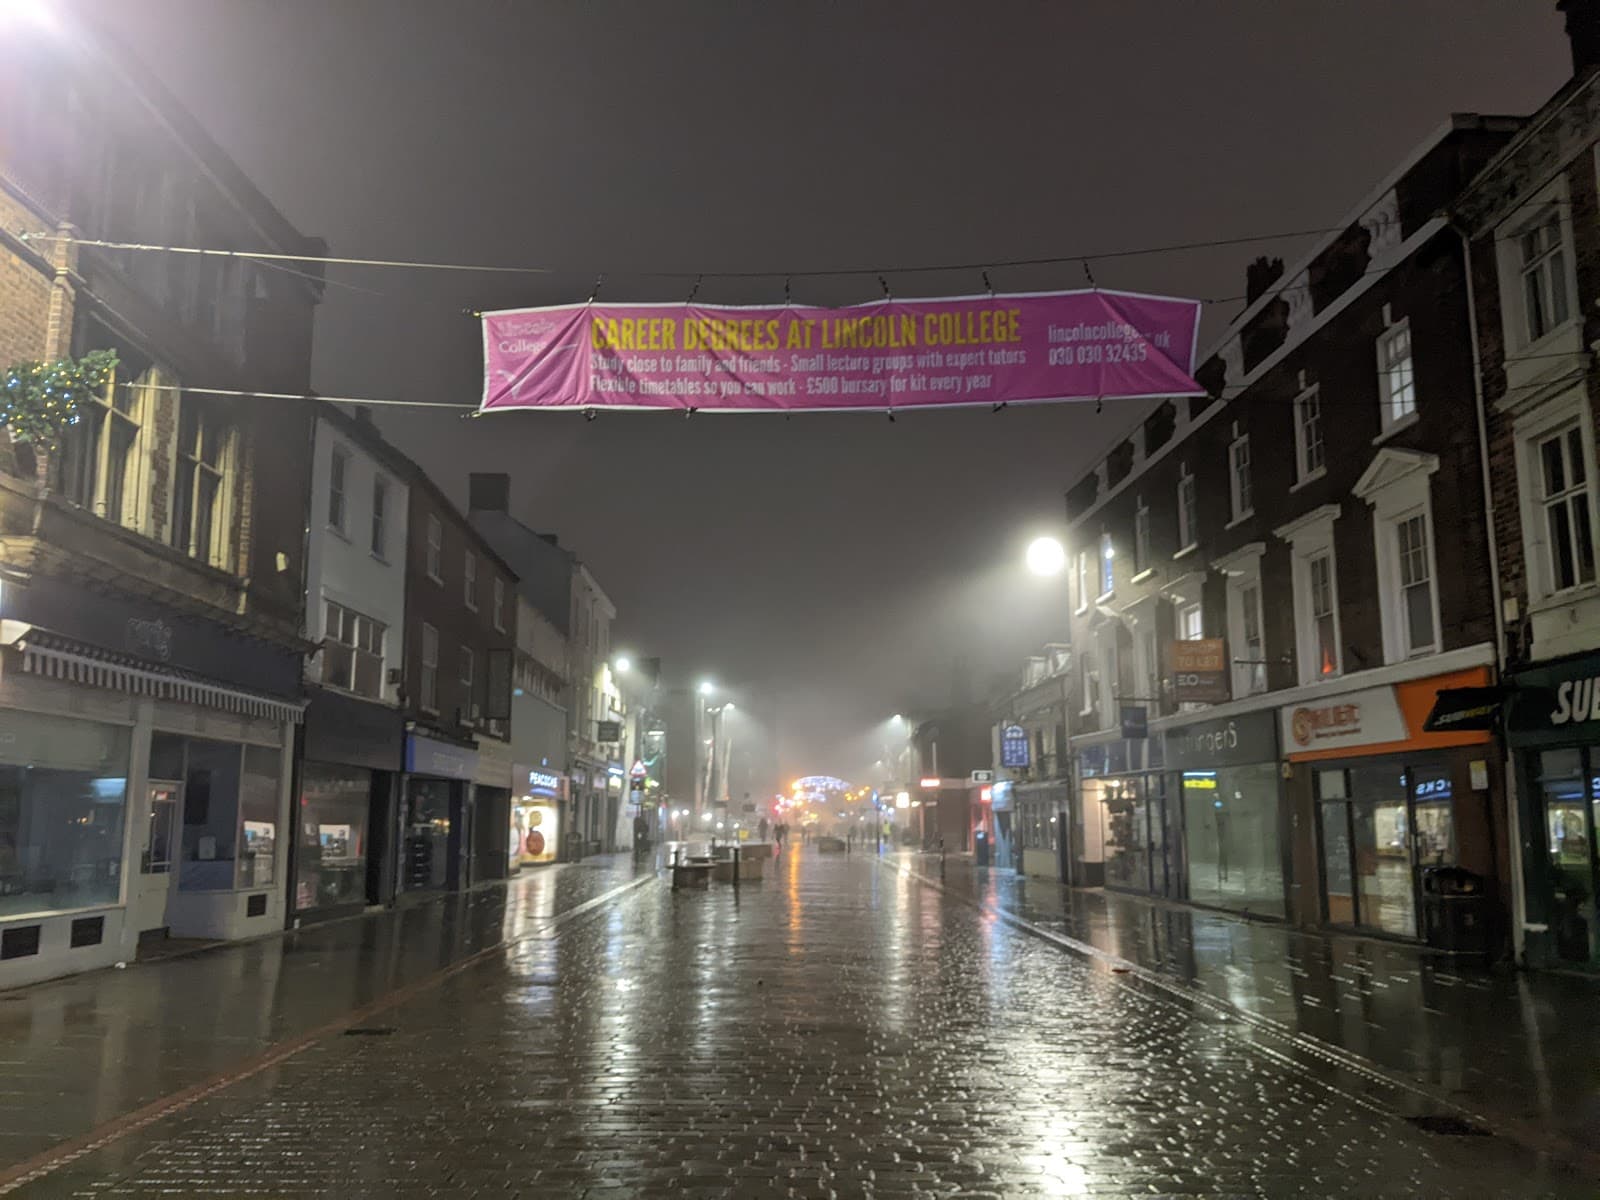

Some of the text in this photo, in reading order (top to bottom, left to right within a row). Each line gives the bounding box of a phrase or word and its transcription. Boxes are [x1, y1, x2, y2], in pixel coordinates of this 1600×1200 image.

[592, 310, 1022, 351] CAREER DEGREES AT LINCOLN COLLEGE
[498, 339, 549, 355] Colleg
[1049, 347, 1074, 366] 030
[1078, 346, 1103, 364] 030
[591, 354, 625, 374] Study
[627, 355, 657, 373] close
[661, 356, 673, 372] to
[675, 355, 713, 376] family
[715, 355, 738, 372] and
[740, 355, 781, 372] friends
[791, 354, 825, 371] Small
[827, 353, 869, 371] lecture
[872, 355, 913, 374] groups
[918, 351, 942, 369] with
[946, 350, 985, 371] expert
[988, 349, 1026, 366] tutors
[591, 376, 636, 394] Flexible
[639, 377, 700, 395] timetables
[703, 380, 718, 395] so
[720, 380, 741, 398] you
[744, 380, 765, 395] can
[768, 377, 796, 395] work
[807, 376, 838, 394] £500
[841, 376, 887, 397] bursary
[890, 375, 907, 393] for
[910, 374, 928, 392] kit
[931, 374, 962, 395] every
[966, 373, 992, 392] year
